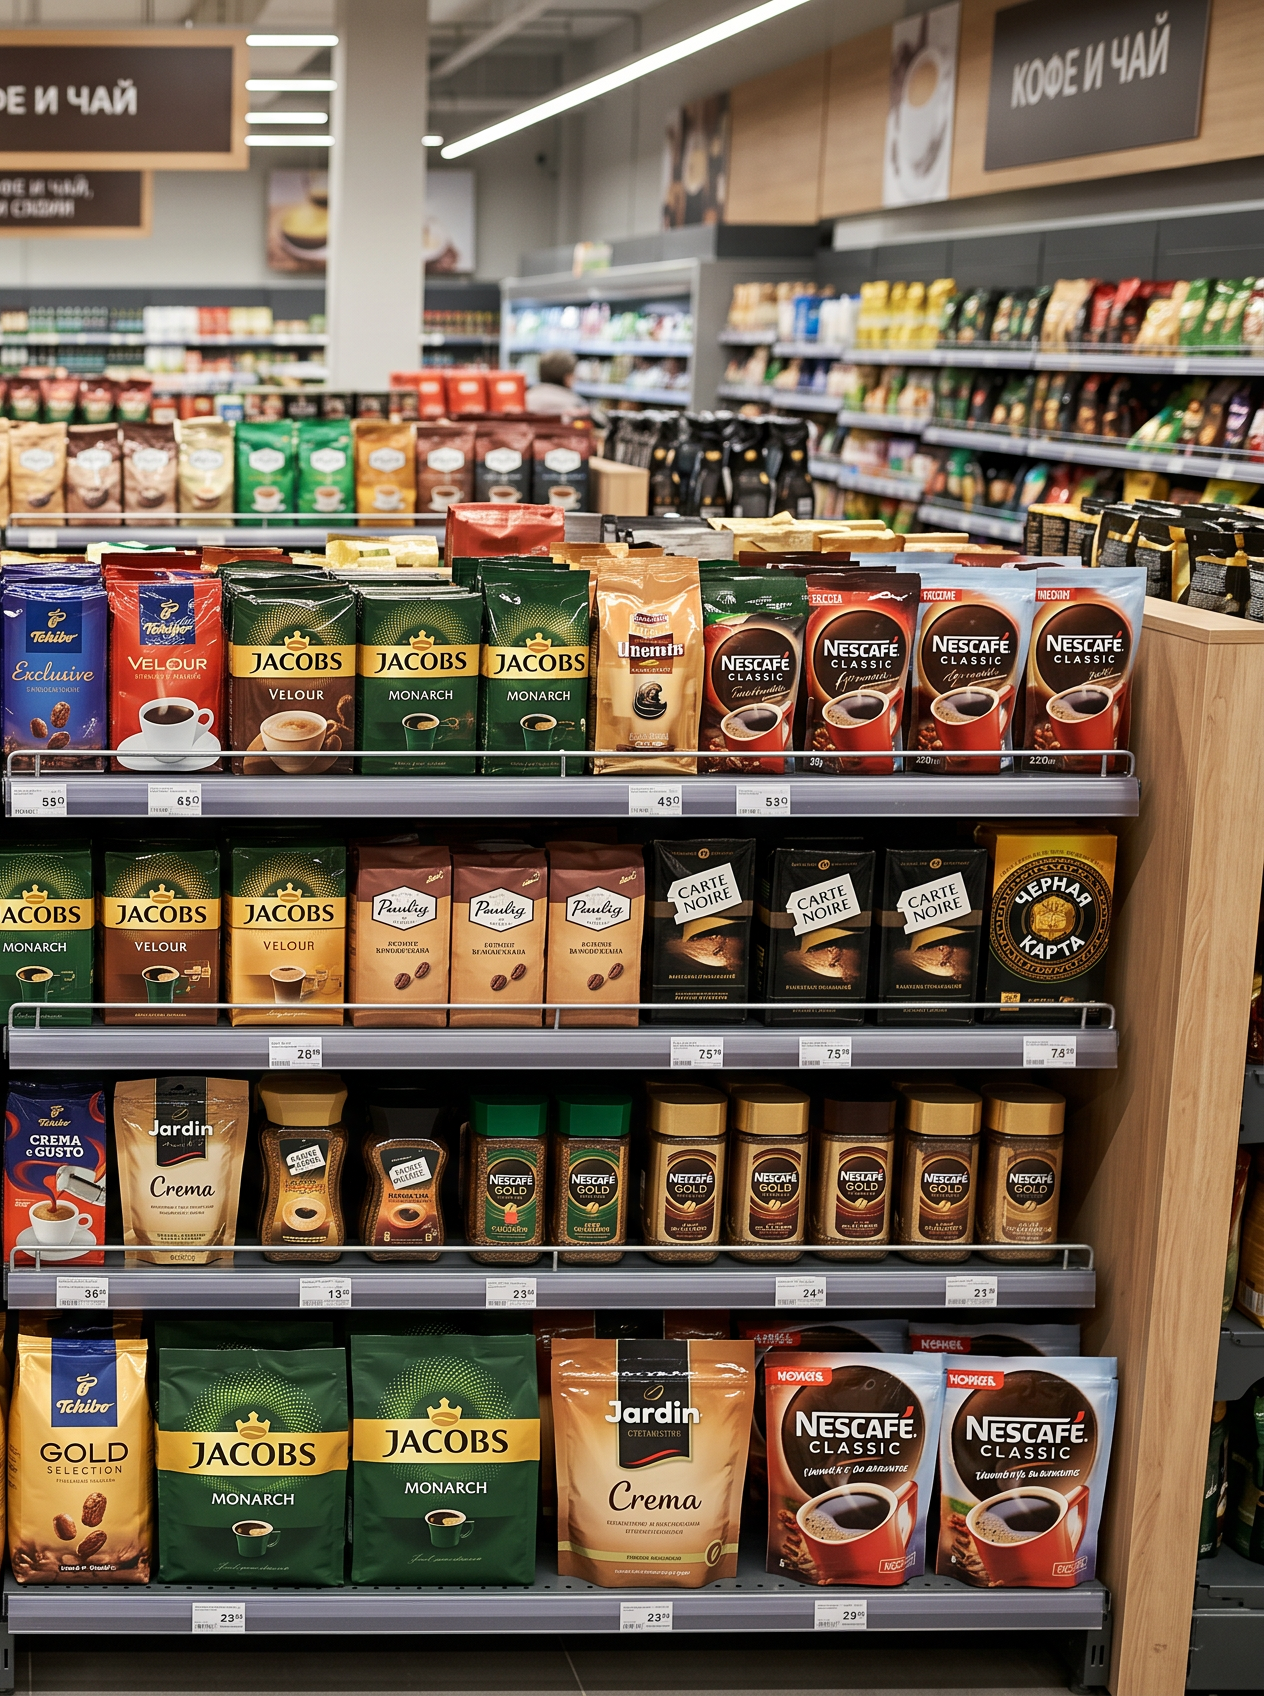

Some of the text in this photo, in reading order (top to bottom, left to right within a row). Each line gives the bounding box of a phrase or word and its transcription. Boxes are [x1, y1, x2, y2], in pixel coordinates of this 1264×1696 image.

[1011, 10, 1171, 109] КОФЕ И ЧАЙ
[35, 86, 58, 114] И
[67, 79, 137, 114] ЧАЙ
[30, 629, 78, 645] Tchibo
[127, 656, 207, 672] VELOUR
[249, 651, 343, 674] JACOBS
[374, 651, 467, 674] JACOBS
[493, 652, 585, 674] JACOBS
[831, 659, 892, 669] CLASSIC
[940, 655, 1002, 666] CLASSIC
[1053, 654, 1115, 664] CLASSIC
[11, 660, 95, 684] Exclusive
[728, 672, 783, 682] CLASSIC
[268, 688, 324, 701] VELOUR
[388, 689, 454, 701] MONARCH
[507, 689, 570, 701] MONARCH
[677, 873, 729, 900] CARTE
[1014, 876, 1093, 908] ЧЕРНАЯ
[683, 887, 733, 914] NOIRE
[796, 884, 847, 911] CARTE
[907, 882, 959, 909] CARTE
[115, 905, 207, 926] JACOBS
[243, 903, 334, 924] JACOBS
[801, 897, 852, 925] NOIRE
[913, 896, 962, 924] NOIRE
[2, 941, 67, 953] MONARCH
[134, 941, 187, 952] VELOUR
[263, 940, 315, 951] VELOUR
[1019, 935, 1085, 960] КАРТА
[148, 1118, 213, 1138] Jardin
[29, 1134, 82, 1148] CREMA
[26, 1144, 84, 1159] e GUSTO
[149, 1175, 216, 1199] Crema
[494, 1185, 528, 1196] GOLD
[577, 1185, 610, 1195] GOLD
[674, 1183, 708, 1194] GOLD
[845, 1181, 879, 1192] GOLD
[929, 1183, 963, 1194] GOLD
[1014, 1184, 1048, 1194] GOLD
[56, 1399, 115, 1415] Tchibo
[605, 1400, 702, 1424] Jardin
[382, 1429, 509, 1458] JACOBS
[809, 1440, 900, 1455] CLASSIC
[40, 1442, 129, 1463] GOLD
[188, 1441, 316, 1469] JACOBS
[981, 1445, 1071, 1459] CLASSIC
[47, 1465, 122, 1475] SELECTION
[404, 1481, 488, 1494] MONARCH
[608, 1480, 702, 1511] Crema
[211, 1492, 295, 1506] MONARCH
